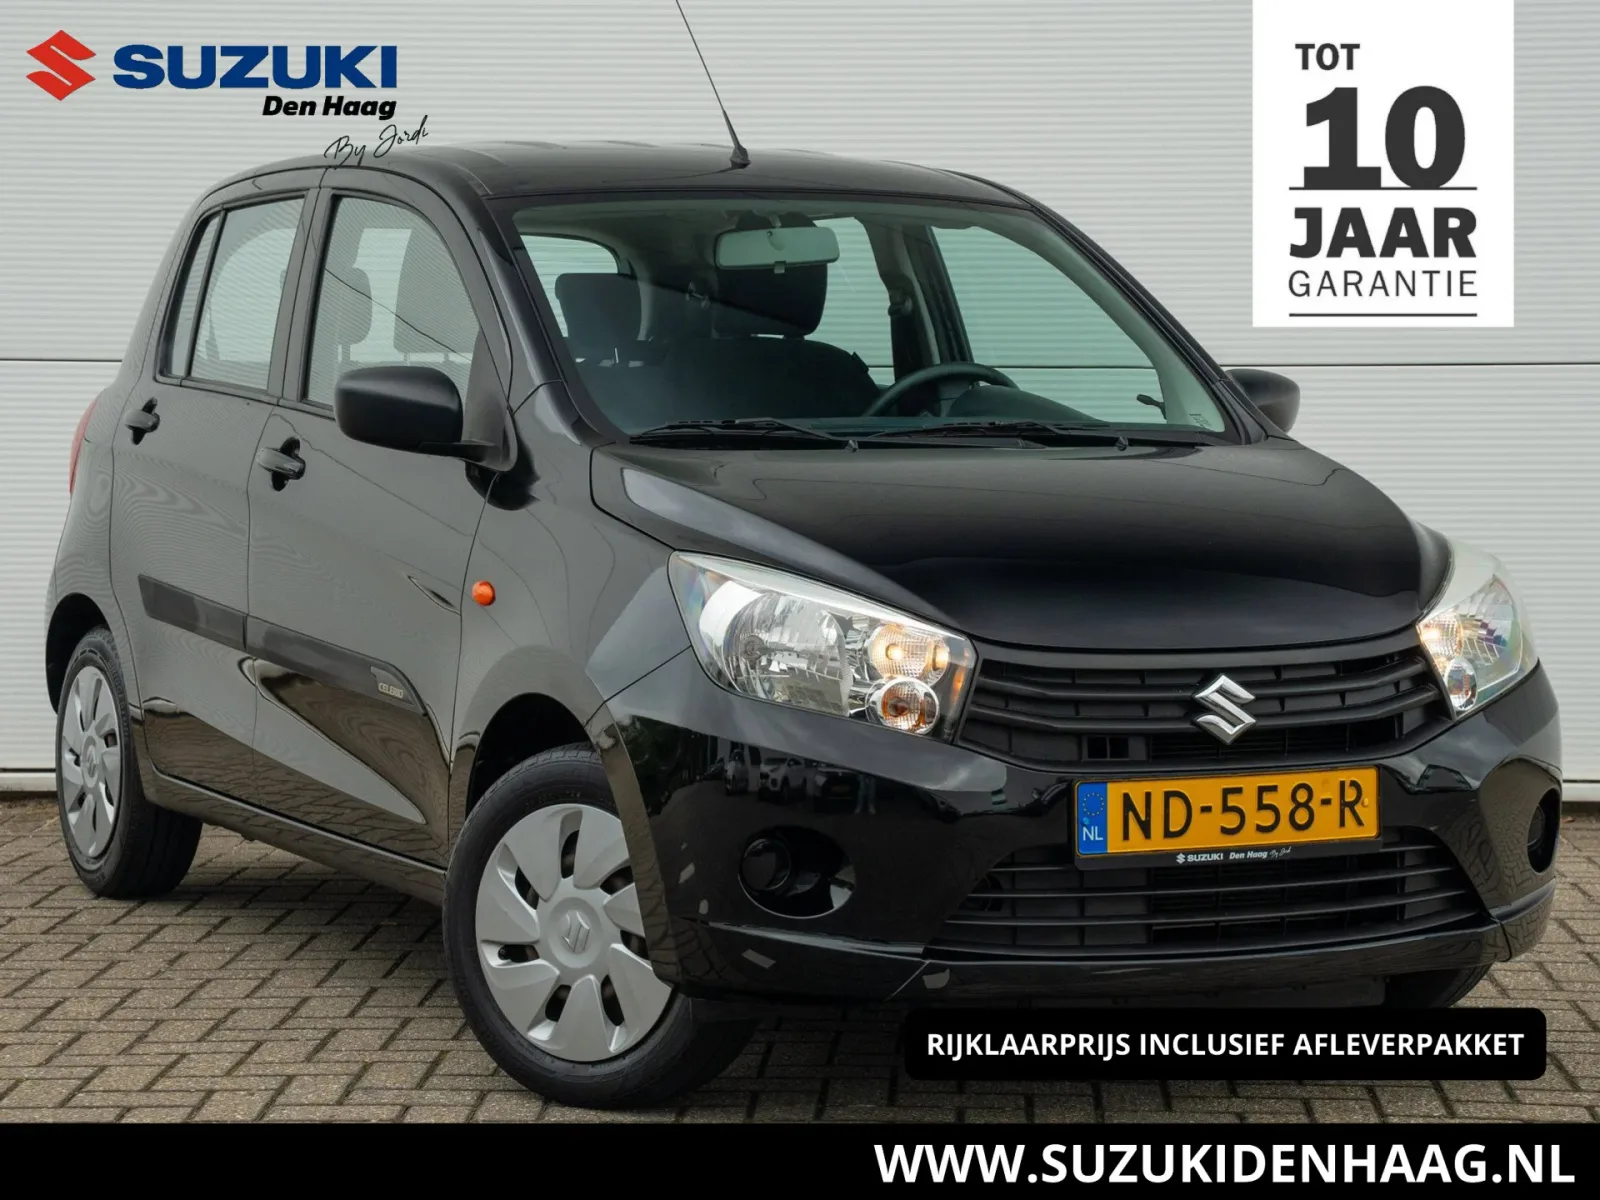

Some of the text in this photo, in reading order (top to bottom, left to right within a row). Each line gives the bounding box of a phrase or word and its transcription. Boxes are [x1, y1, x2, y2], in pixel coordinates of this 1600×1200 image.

[1122, 779, 1365, 842] ND-558-R
[1082, 826, 1104, 841] NL
[1187, 852, 1224, 862] SUZUKI
[1229, 851, 1245, 860] Den
[1246, 850, 1269, 860] Haag
